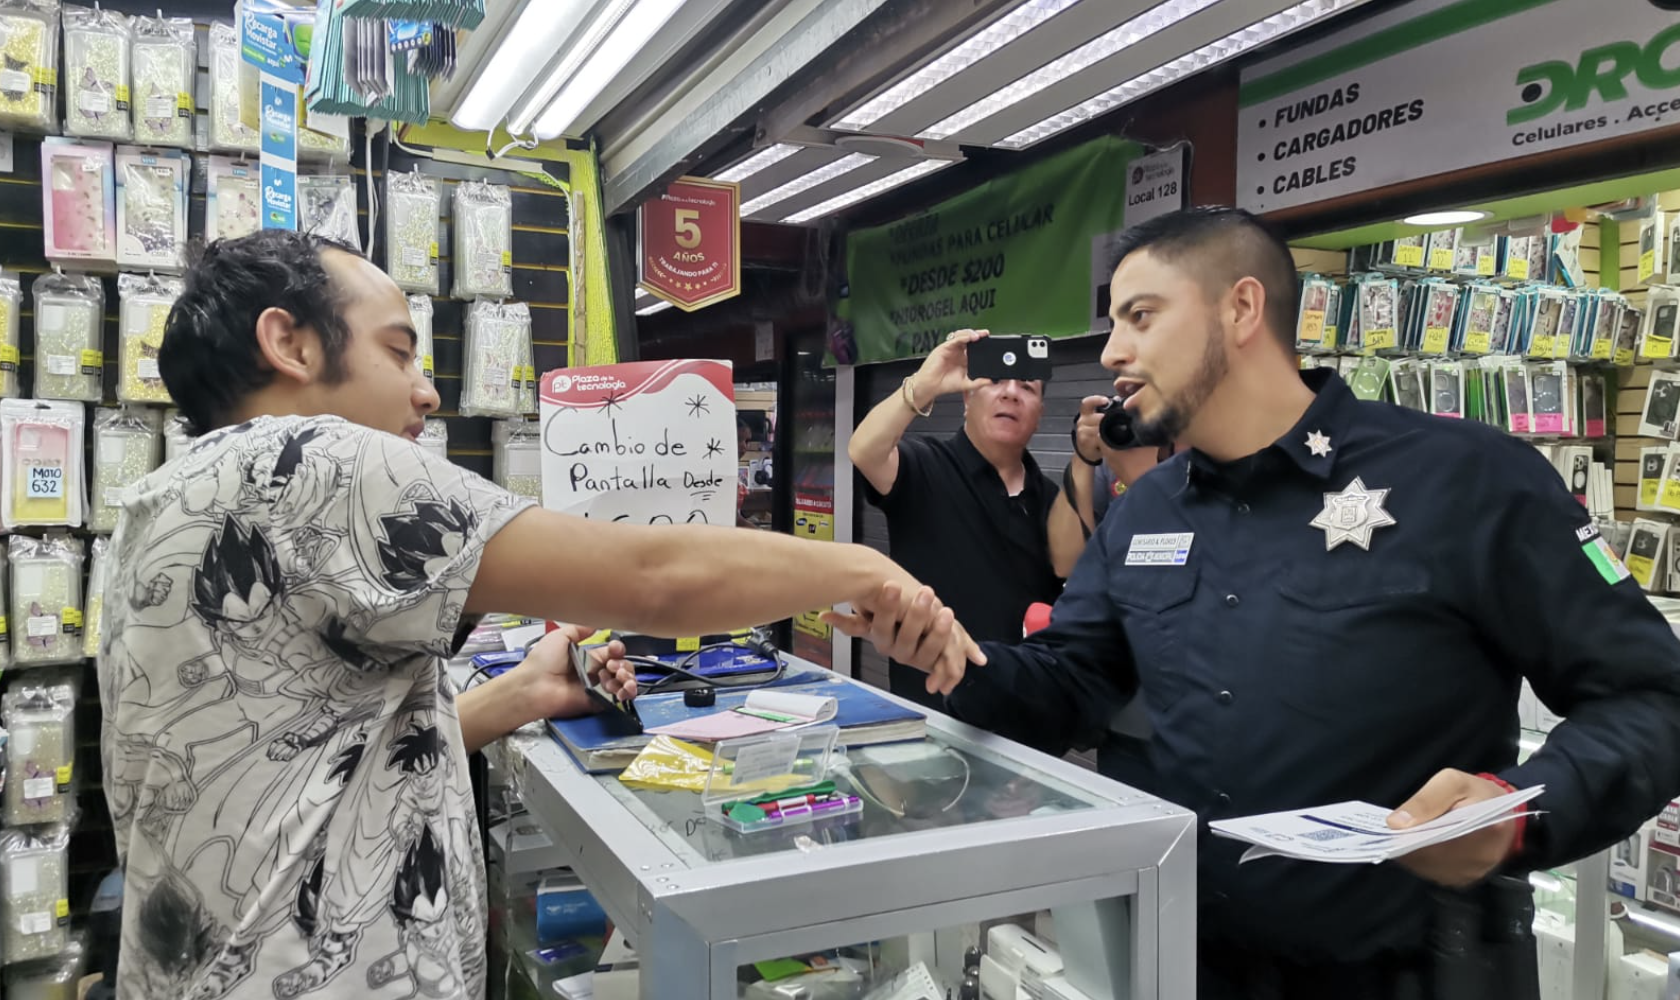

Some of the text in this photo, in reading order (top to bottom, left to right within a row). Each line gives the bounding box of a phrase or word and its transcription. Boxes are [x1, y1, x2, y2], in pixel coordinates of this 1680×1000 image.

[245, 12, 277, 39] Recarga
[246, 30, 277, 50] Movistar
[1274, 83, 1360, 128] FUNDAS
[1273, 99, 1424, 160] CARGADORES
[1512, 116, 1607, 146] Celulares
[1272, 156, 1356, 194] CABLES
[1129, 181, 1178, 206] Local 128
[675, 208, 702, 249] 5
[673, 251, 705, 263] AÑOS
[908, 253, 1005, 296] DESDE $200
[960, 288, 997, 315] AQUI
[572, 375, 599, 383] Plaza
[544, 406, 688, 456] Cambio de
[32, 479, 57, 493] 632
[570, 462, 723, 492] Pantalla Desde
